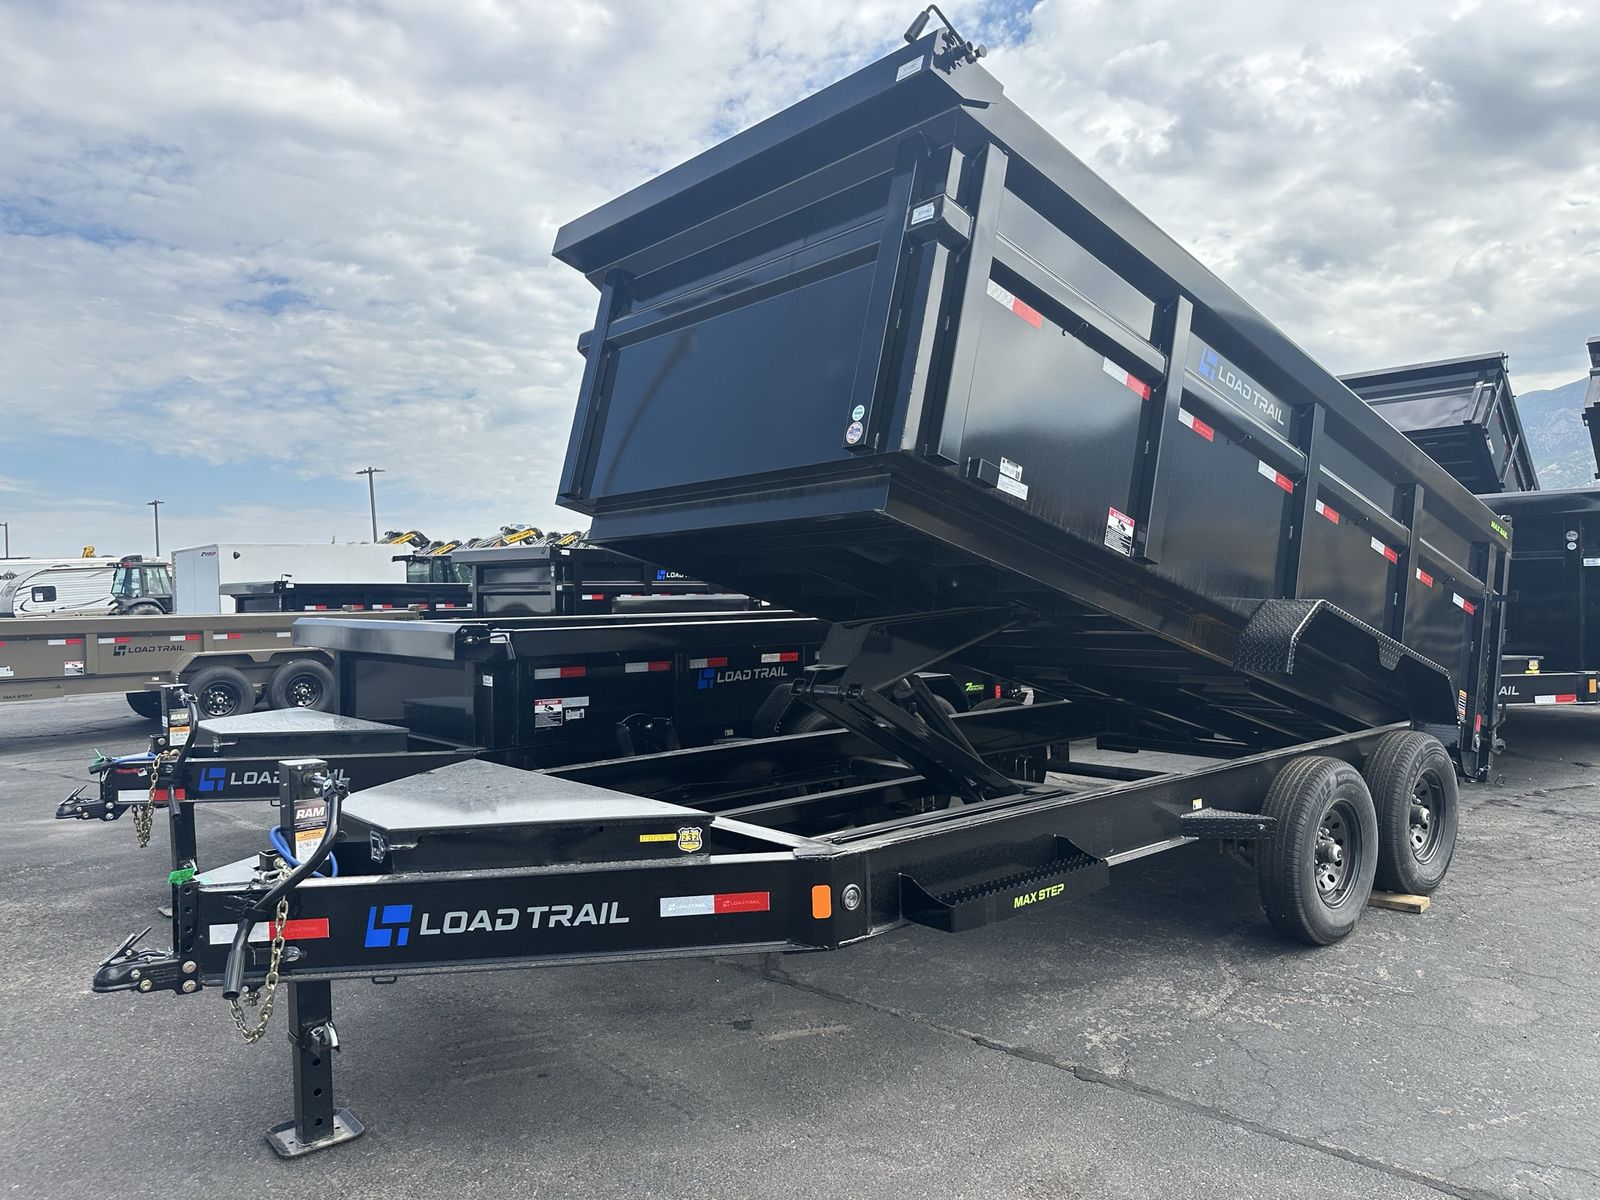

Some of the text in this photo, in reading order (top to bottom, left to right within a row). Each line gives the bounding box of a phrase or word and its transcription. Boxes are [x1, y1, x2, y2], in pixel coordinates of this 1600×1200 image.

[1218, 366, 1284, 426] LOAD TRAIL
[717, 666, 788, 683] LOAD TRAIL
[1498, 686, 1520, 696] AIL
[170, 713, 189, 721] RAM
[296, 806, 325, 820] RAM
[683, 833, 698, 841] 232
[1014, 883, 1064, 908] MAX STEP
[419, 901, 630, 936] LOAD TRAIL
